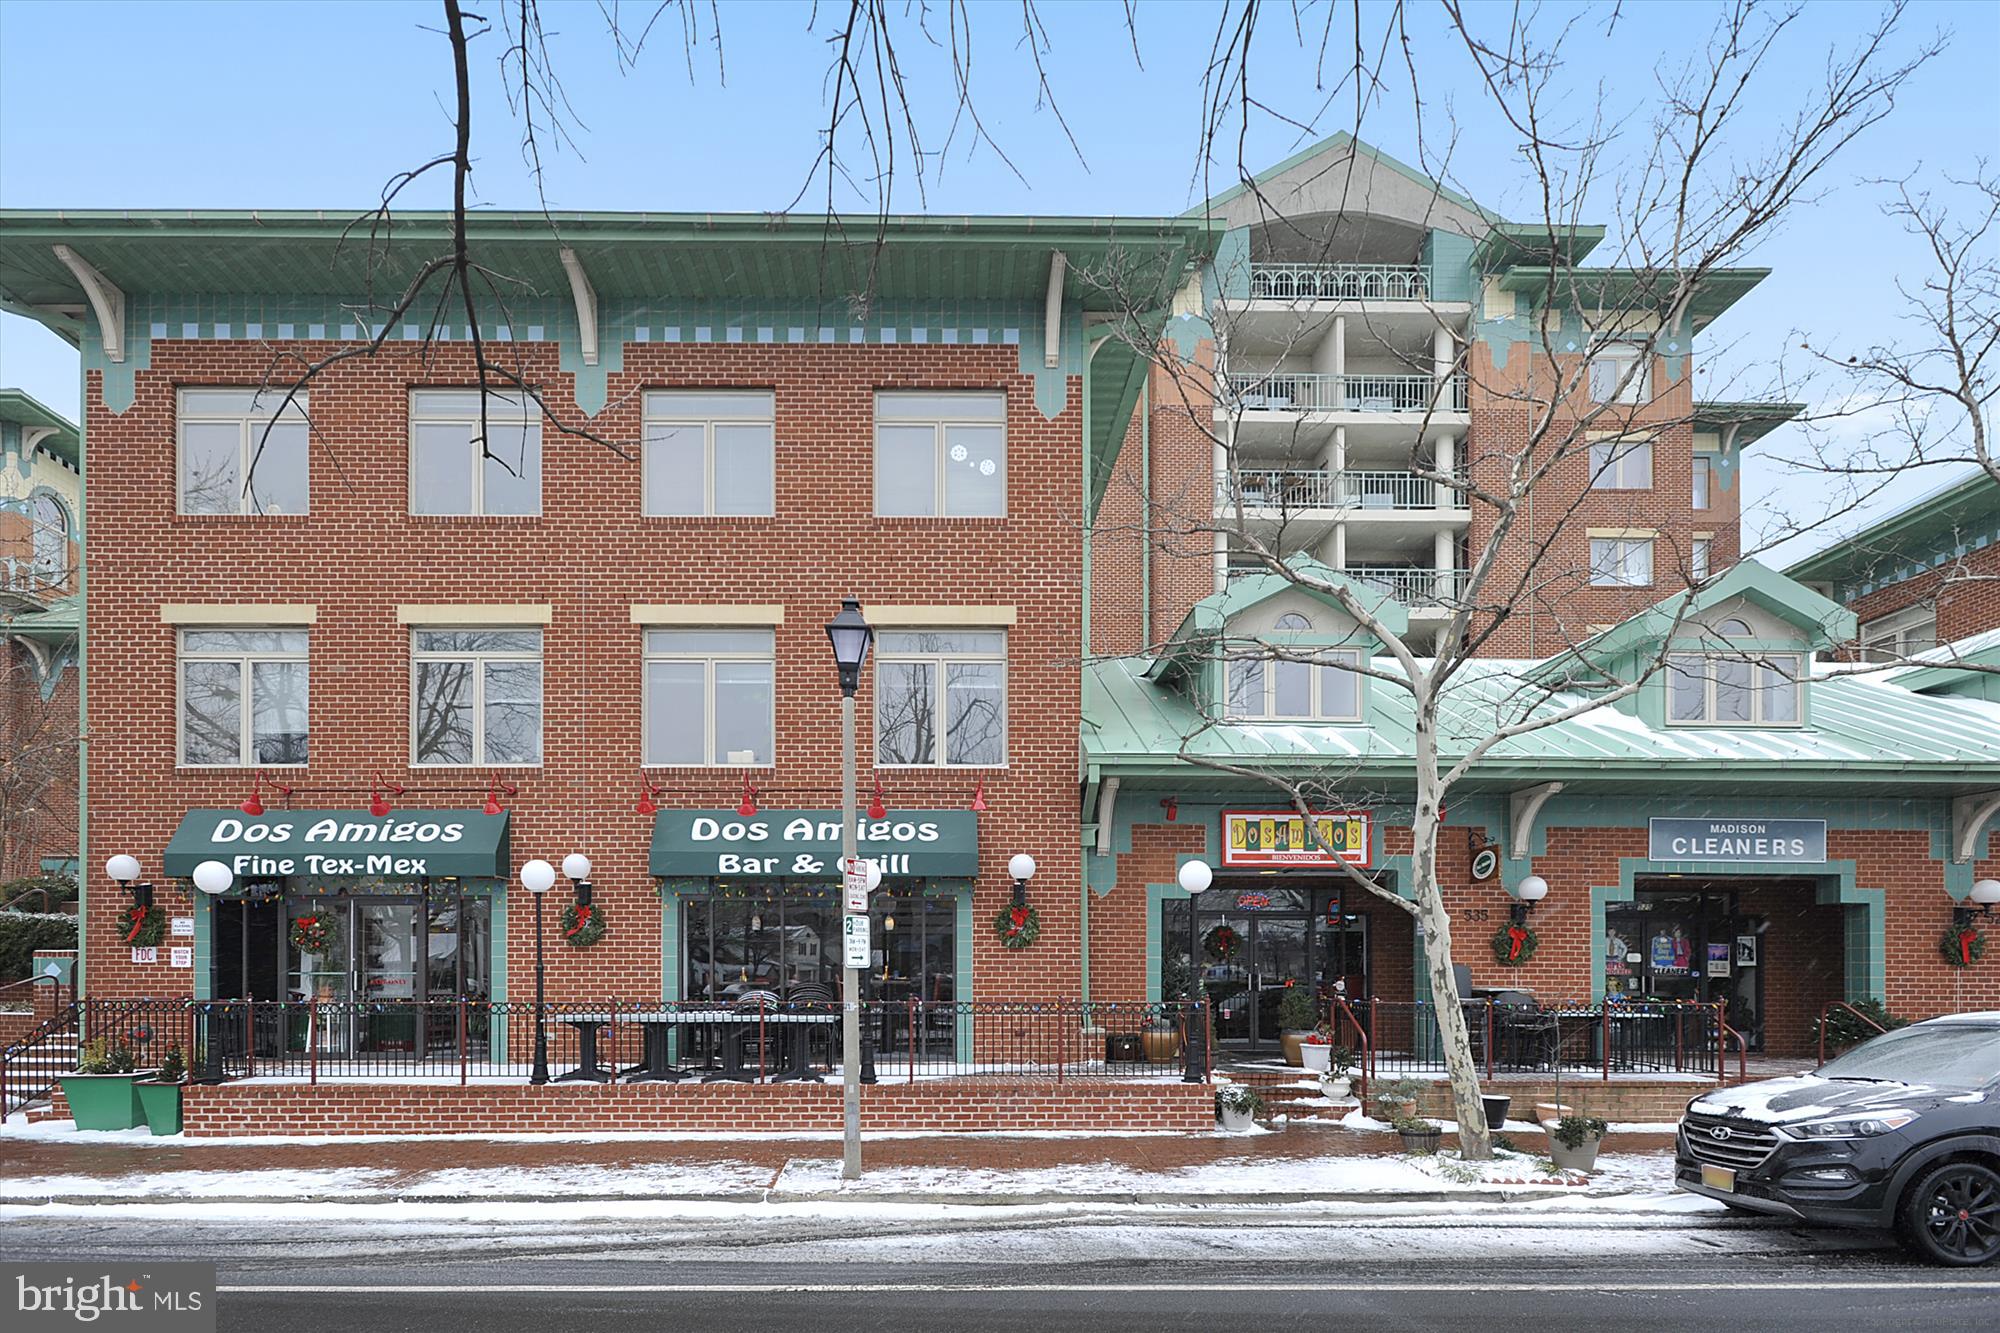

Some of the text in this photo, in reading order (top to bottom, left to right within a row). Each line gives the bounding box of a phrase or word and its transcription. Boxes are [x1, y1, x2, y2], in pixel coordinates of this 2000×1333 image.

[211, 818, 465, 843] Dos Amigos
[691, 817, 939, 842] Dos Amigos
[1710, 824, 1766, 834] MADISON
[1671, 837, 1805, 856] CLEANERS
[233, 855, 426, 875] Fine Tex-Mex
[718, 854, 780, 874] Bar
[791, 854, 825, 874] &
[1237, 895, 1269, 907] OPEN
[1464, 910, 1489, 921] 535
[847, 920, 852, 933] 2
[135, 948, 153, 961] FDC
